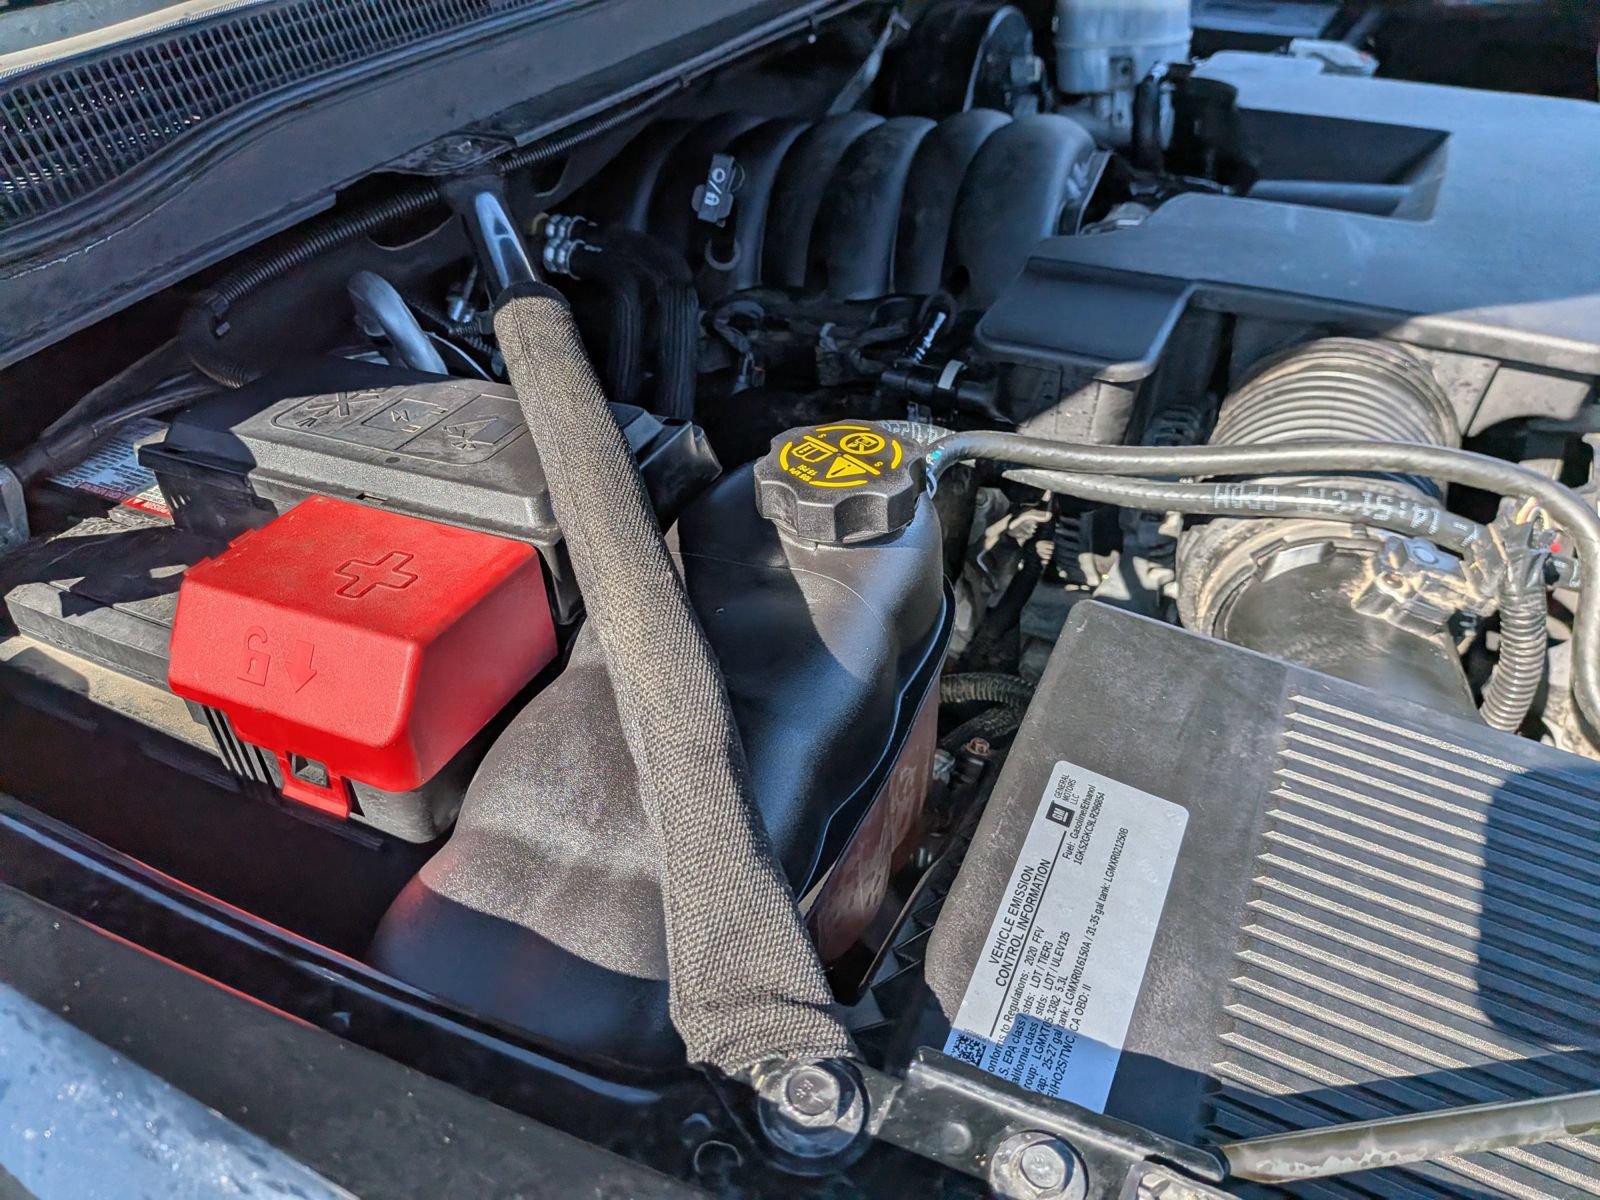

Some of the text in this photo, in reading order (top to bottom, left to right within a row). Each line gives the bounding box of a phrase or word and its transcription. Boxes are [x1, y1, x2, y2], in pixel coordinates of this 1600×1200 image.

[1053, 774, 1070, 799] GENERAL
[1061, 778, 1077, 802] MOTORS
[1069, 792, 1080, 805] LLC
[1051, 807, 1065, 821] GM
[1061, 783, 1096, 860] Fuel: Gasoline/Ethanol
[1097, 882, 1111, 902] tank:
[987, 864, 1035, 964] VEHICLE EMISSION
[1094, 900, 1105, 916] gal
[995, 858, 1051, 987] CONTROL INFORMATION
[1085, 913, 1100, 936] 31-35
[1062, 941, 1092, 1006] LGMXR016150A
[987, 925, 1045, 1073] onforms to Regulations: 2020 FFV
[1001, 1045, 1018, 1065] EPA
[1010, 1018, 1026, 1044] class
[1022, 992, 1036, 1015] stds:
[1029, 968, 1043, 989] LDT
[1036, 940, 1054, 965] TIER3
[1007, 1046, 1031, 1084] alifornia
[1023, 1021, 1039, 1046] class
[1035, 993, 1049, 1016] stds:
[1042, 971, 1056, 991] LDT
[1049, 930, 1070, 968] ULEV125
[1073, 991, 1090, 1016] OBD:
[1055, 1006, 1070, 1029] tank:
[1068, 1017, 1081, 1032] CA
[1023, 975, 1069, 1090] roup: LGMXT05.3382 5.3L
[1051, 1027, 1063, 1045] gal
[1041, 1042, 1058, 1071] 25-27
